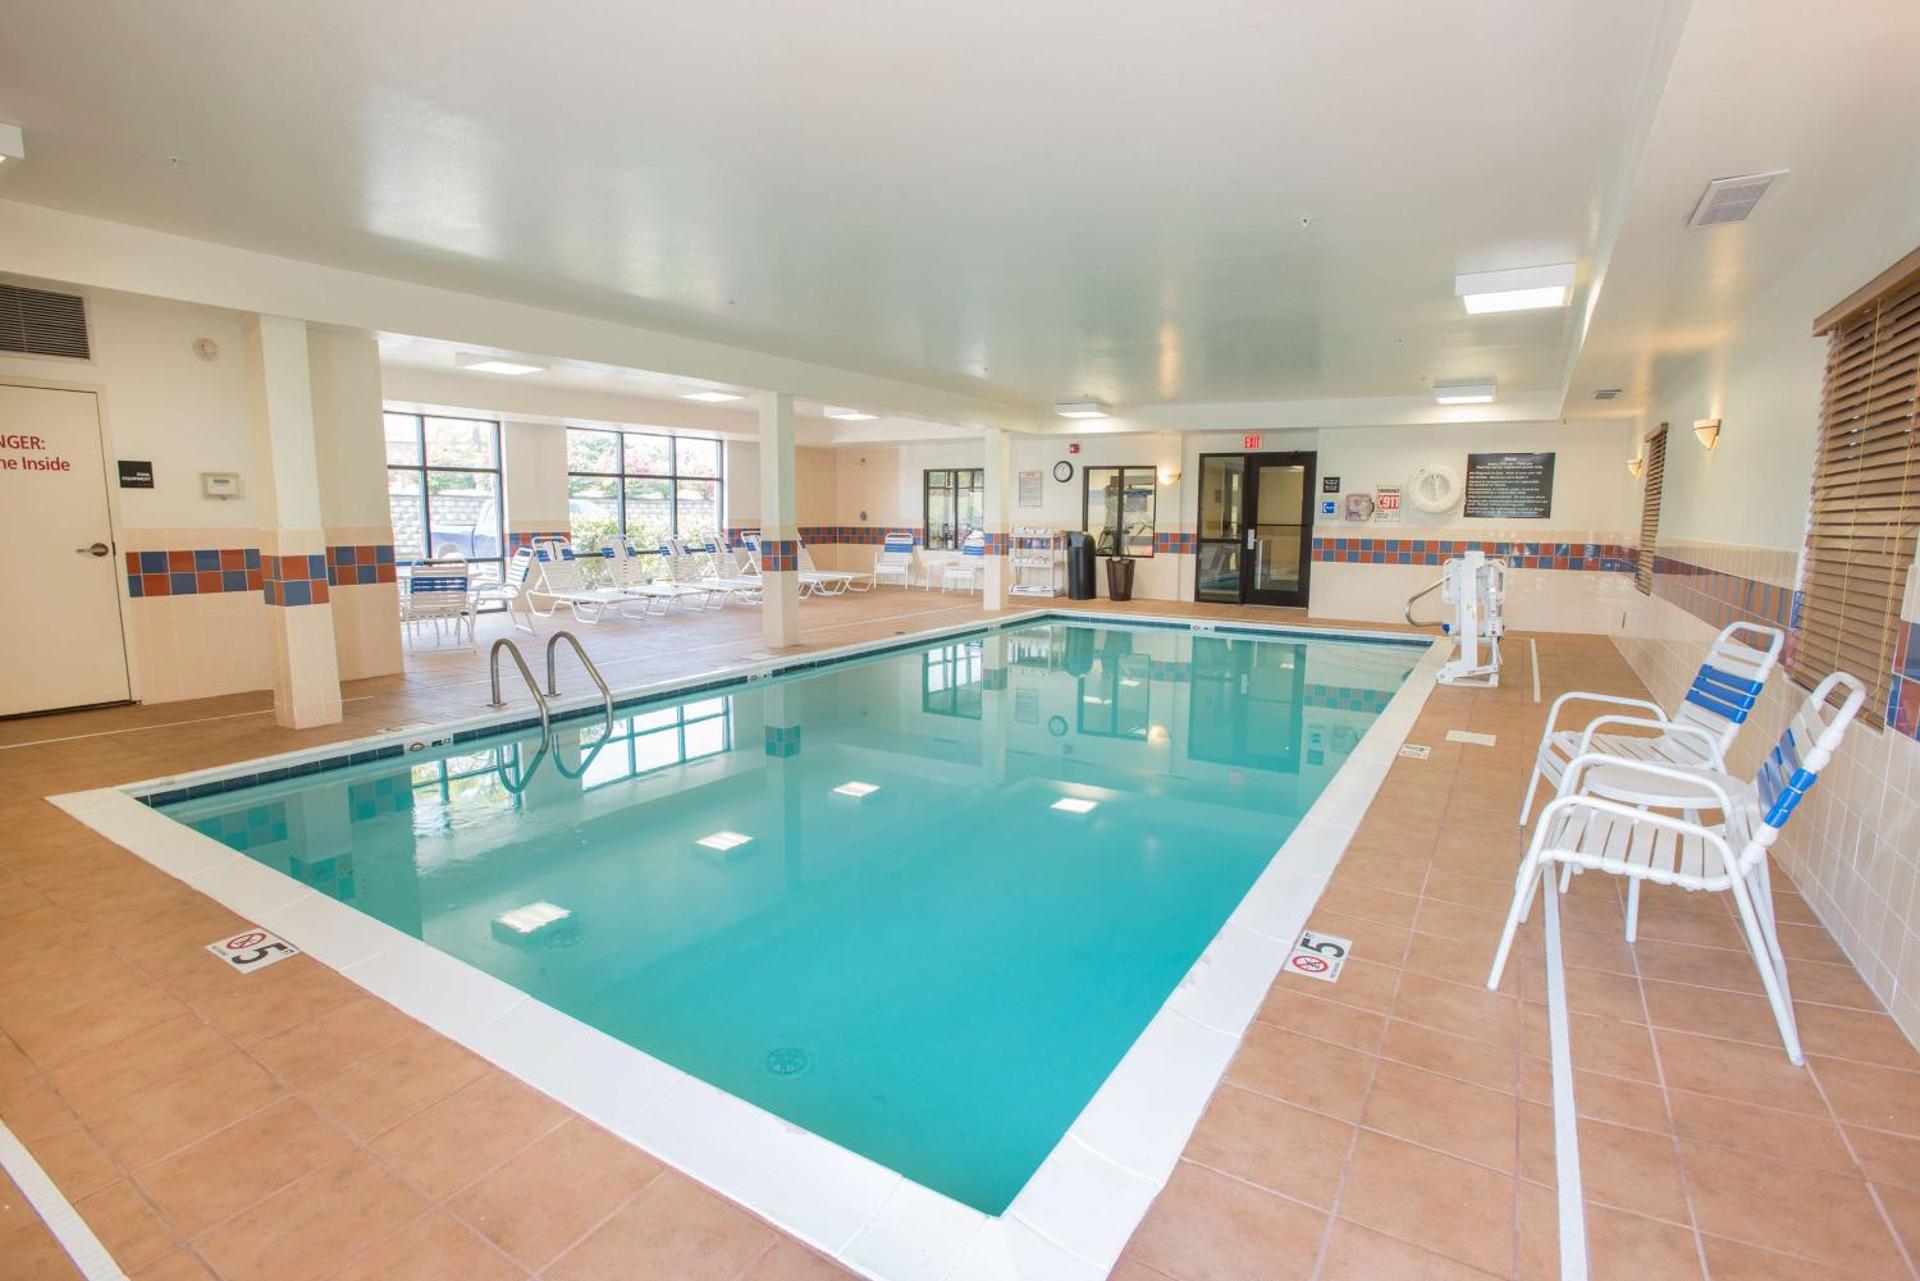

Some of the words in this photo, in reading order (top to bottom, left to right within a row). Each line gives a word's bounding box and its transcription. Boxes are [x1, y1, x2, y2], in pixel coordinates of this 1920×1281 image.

[1244, 436, 1260, 448] EXIT
[22, 456, 71, 471] Inside
[231, 942, 288, 965] 5
[1301, 937, 1345, 958] 5
